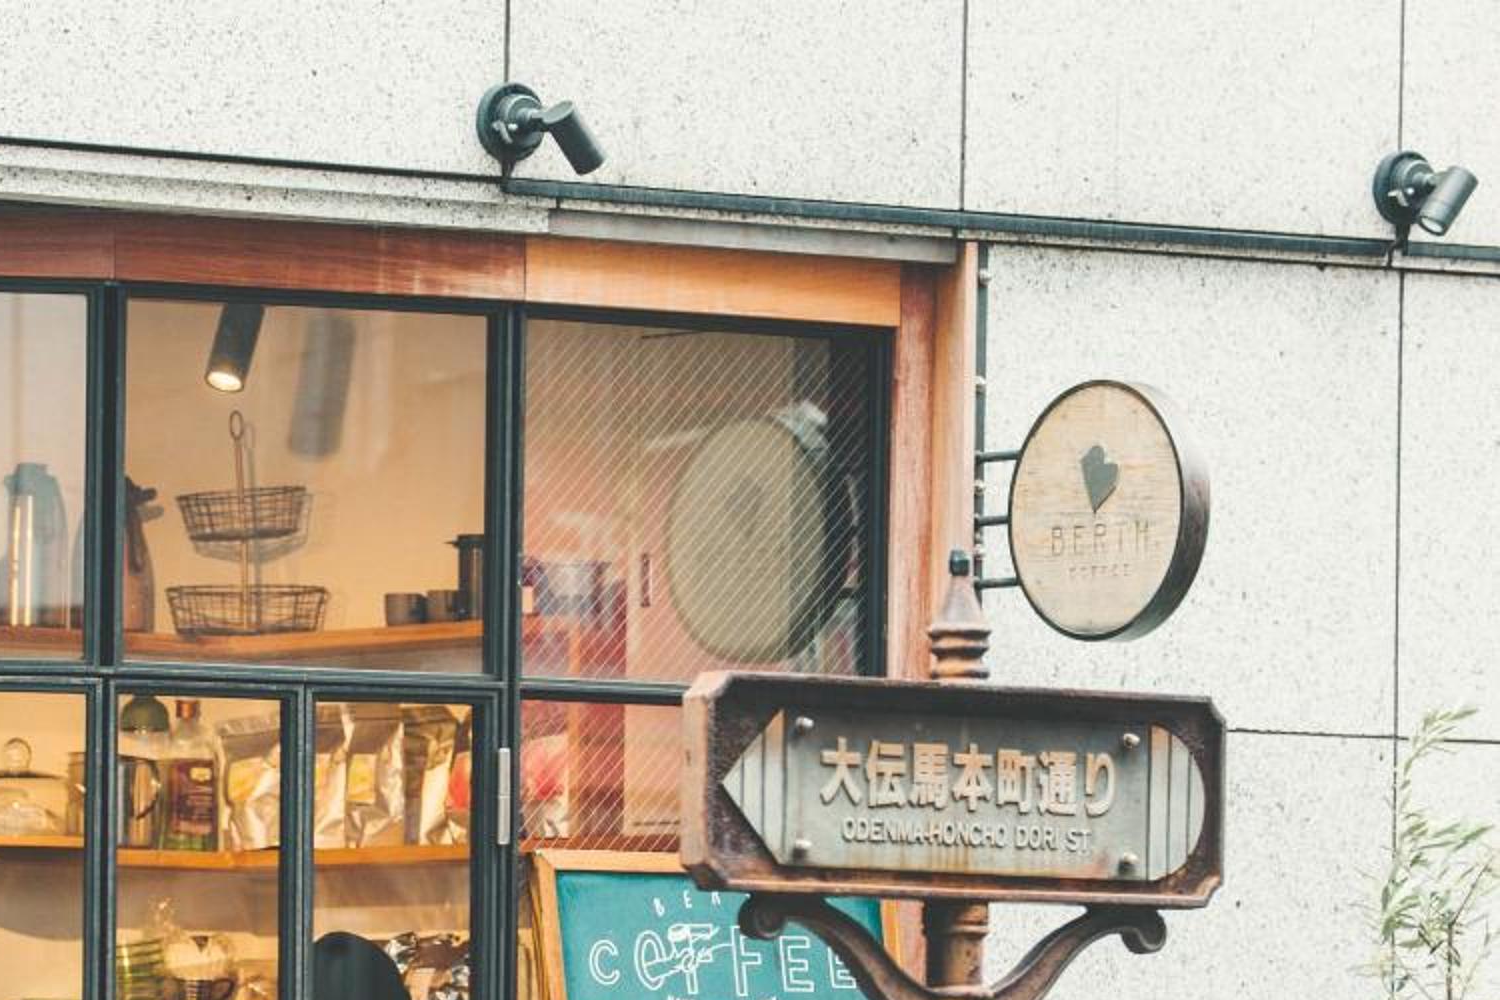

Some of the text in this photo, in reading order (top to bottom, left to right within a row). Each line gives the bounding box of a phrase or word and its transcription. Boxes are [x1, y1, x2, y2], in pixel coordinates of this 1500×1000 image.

[1050, 519, 1151, 557] BERTH
[819, 735, 1117, 817] 大伝馬本町通り
[842, 815, 1008, 849] ODENMA-HONCHO
[1015, 823, 1060, 851] DORI
